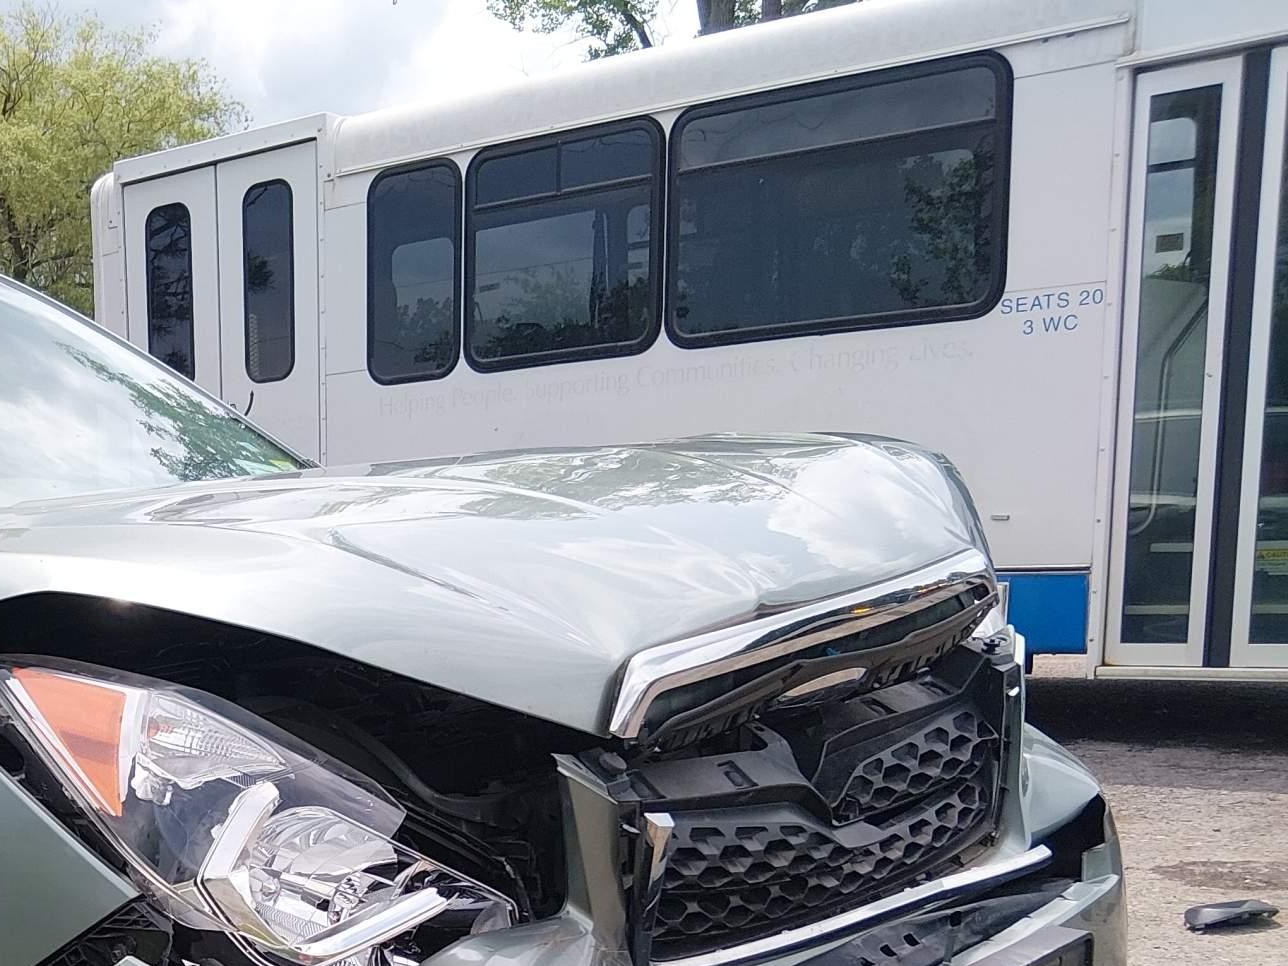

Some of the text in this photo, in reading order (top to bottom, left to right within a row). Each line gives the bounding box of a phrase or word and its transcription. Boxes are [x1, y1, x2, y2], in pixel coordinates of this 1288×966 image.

[1000, 288, 1104, 315] SEATS 20
[1022, 314, 1079, 335] 3 WC
